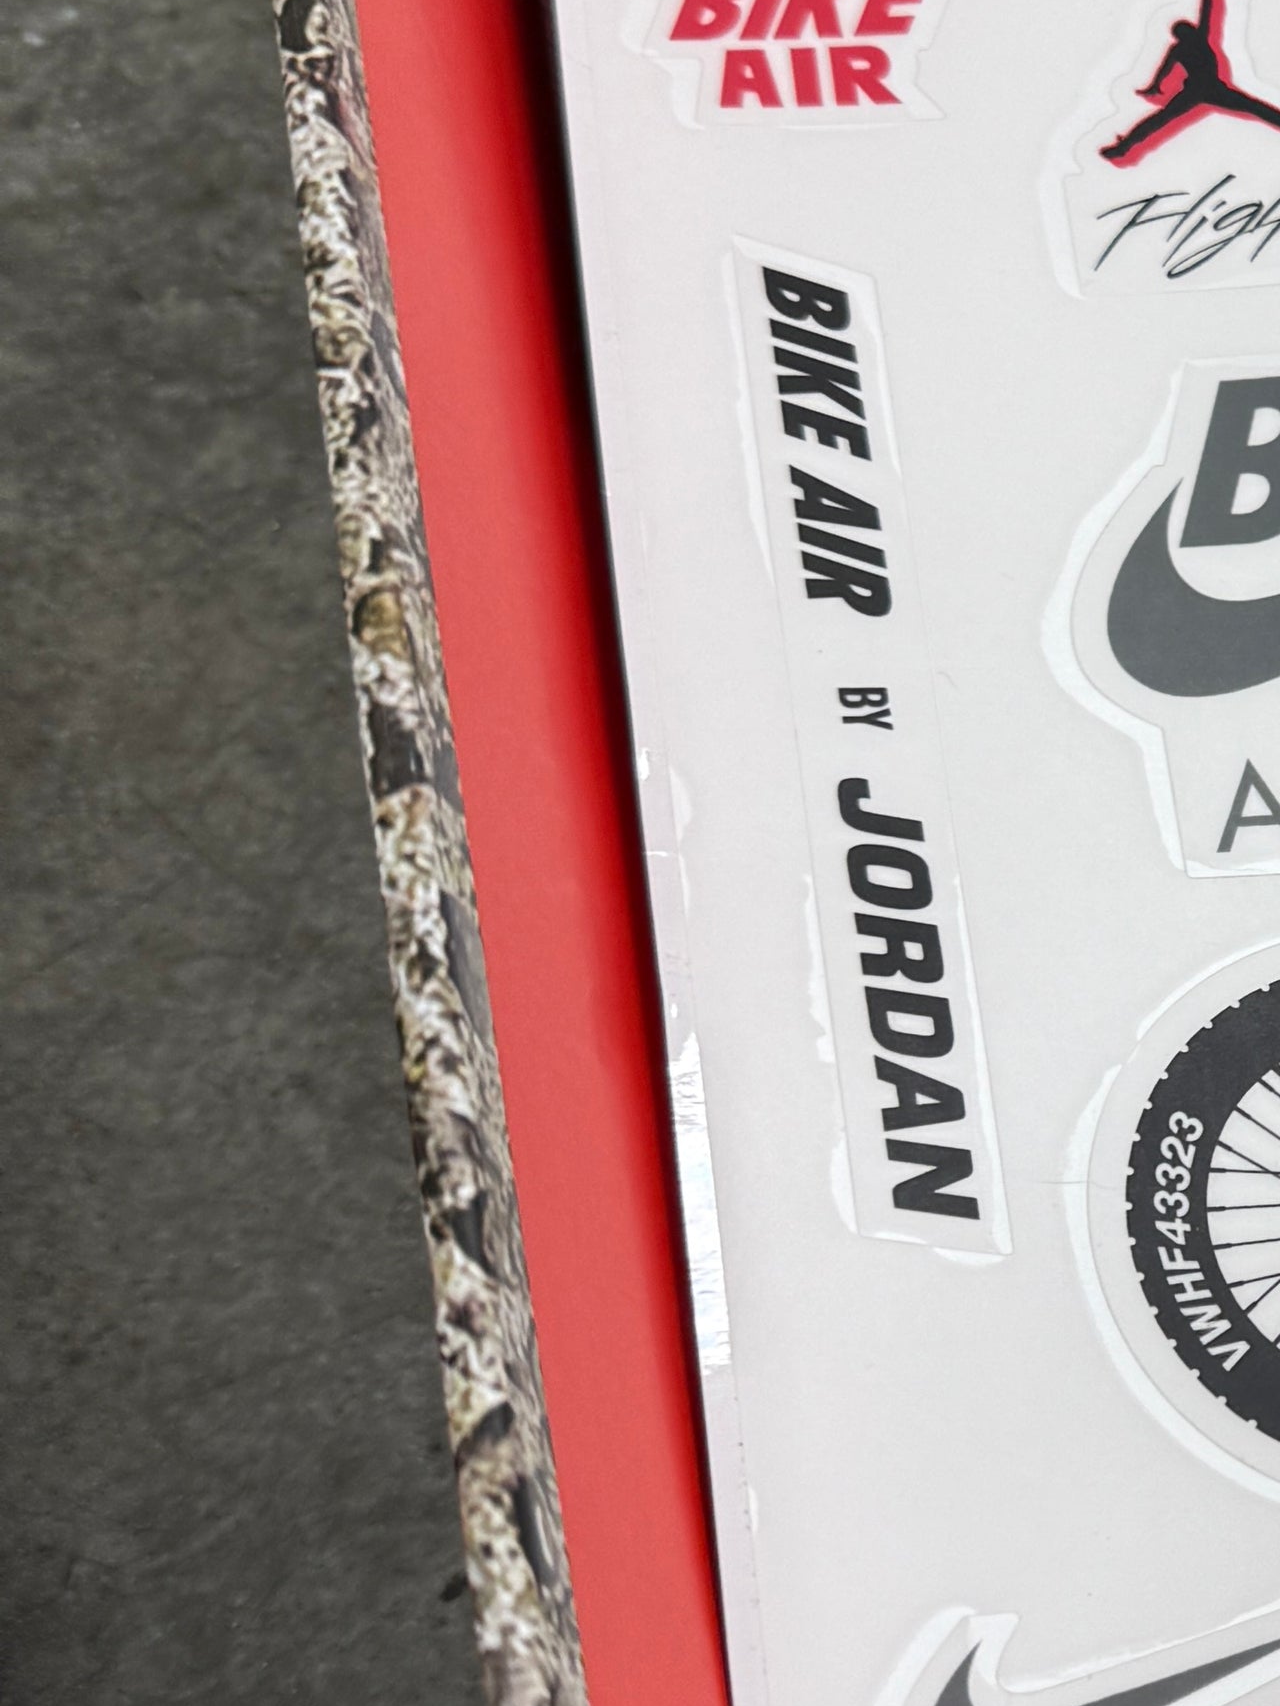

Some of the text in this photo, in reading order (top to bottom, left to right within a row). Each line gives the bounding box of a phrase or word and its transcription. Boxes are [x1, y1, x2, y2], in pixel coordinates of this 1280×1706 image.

[720, 47, 902, 109] AIR
[762, 265, 980, 1221] BIKE AIR BY JORDAN
[1153, 1110, 1251, 1372] VWHF43323
